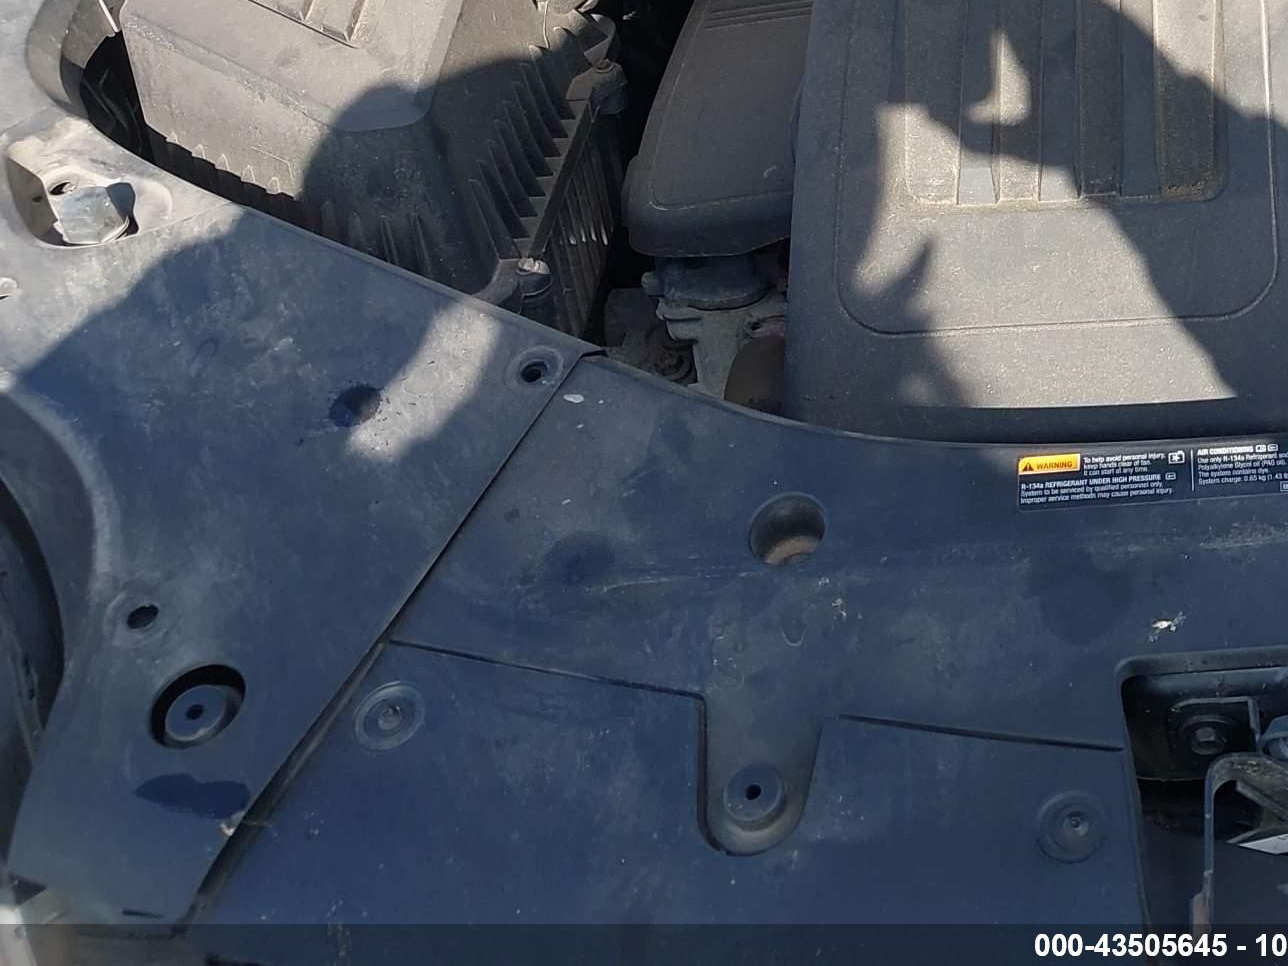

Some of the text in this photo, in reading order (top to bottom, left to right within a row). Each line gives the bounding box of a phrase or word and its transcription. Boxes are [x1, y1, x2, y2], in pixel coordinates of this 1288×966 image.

[1092, 456, 1104, 464] help
[1123, 454, 1147, 462] personal
[1036, 461, 1072, 470] WARNING
[1045, 479, 1087, 488] REFRIGERANT
[1129, 474, 1161, 482] PRESSURE
[1094, 484, 1119, 492] qualified
